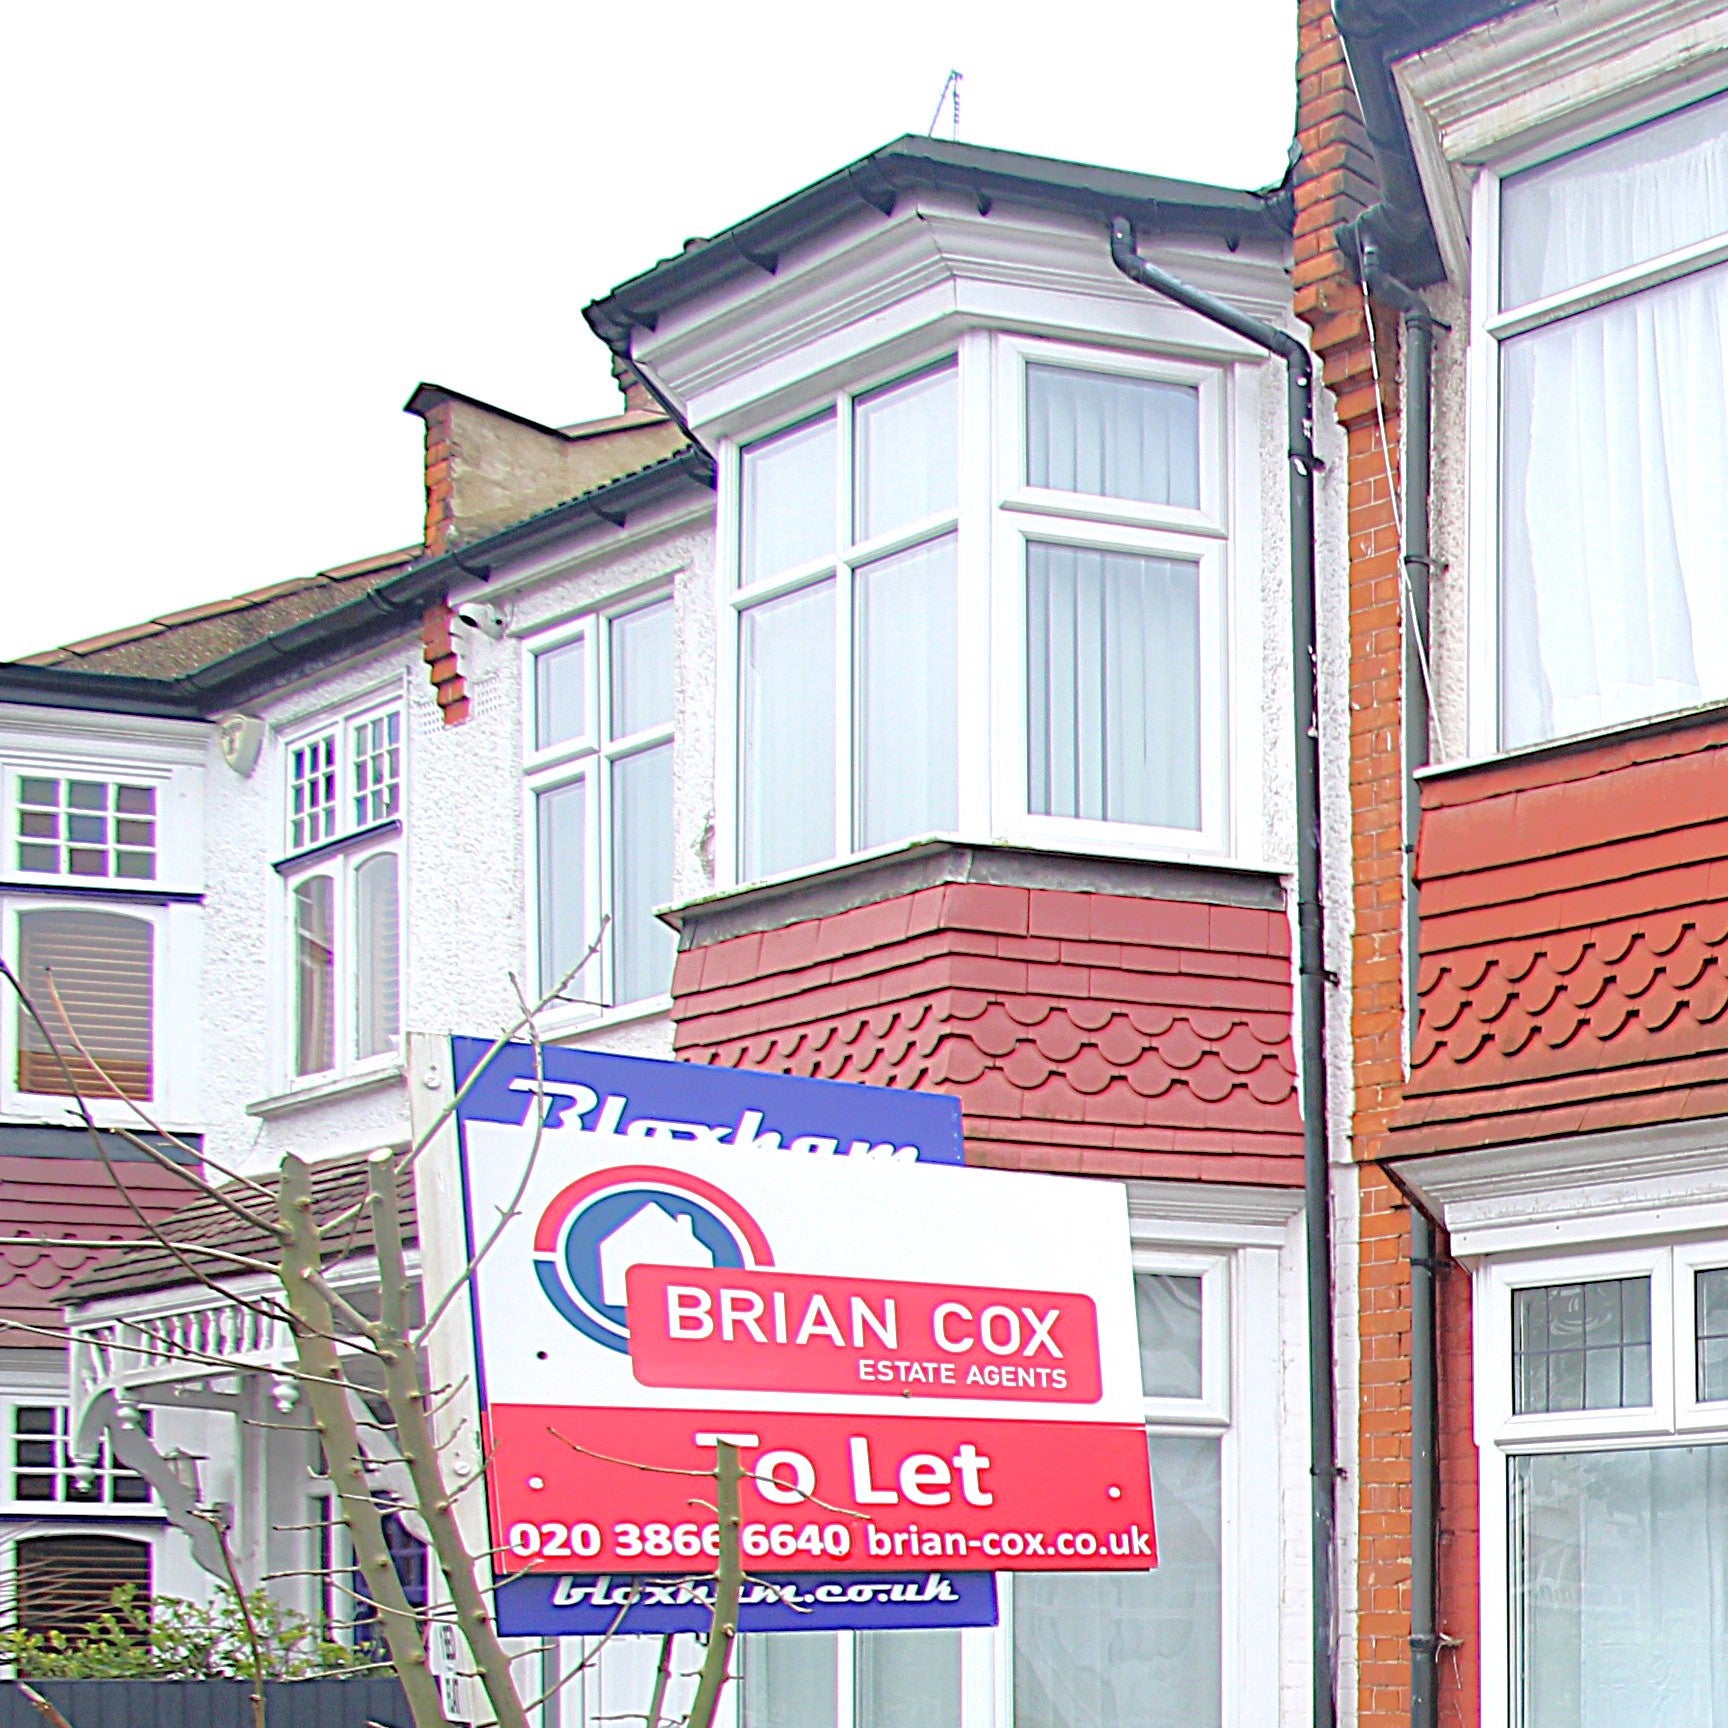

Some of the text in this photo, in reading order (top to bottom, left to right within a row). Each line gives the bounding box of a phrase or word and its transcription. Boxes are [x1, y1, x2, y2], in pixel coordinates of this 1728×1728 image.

[666, 1285, 1065, 1359] BRIAN COX
[858, 1359, 1068, 1389] ESTATE AGENTS
[849, 1435, 995, 1507] Let
[508, 1522, 1152, 1557] 020 3866 6640 brian-cox.co.uk
